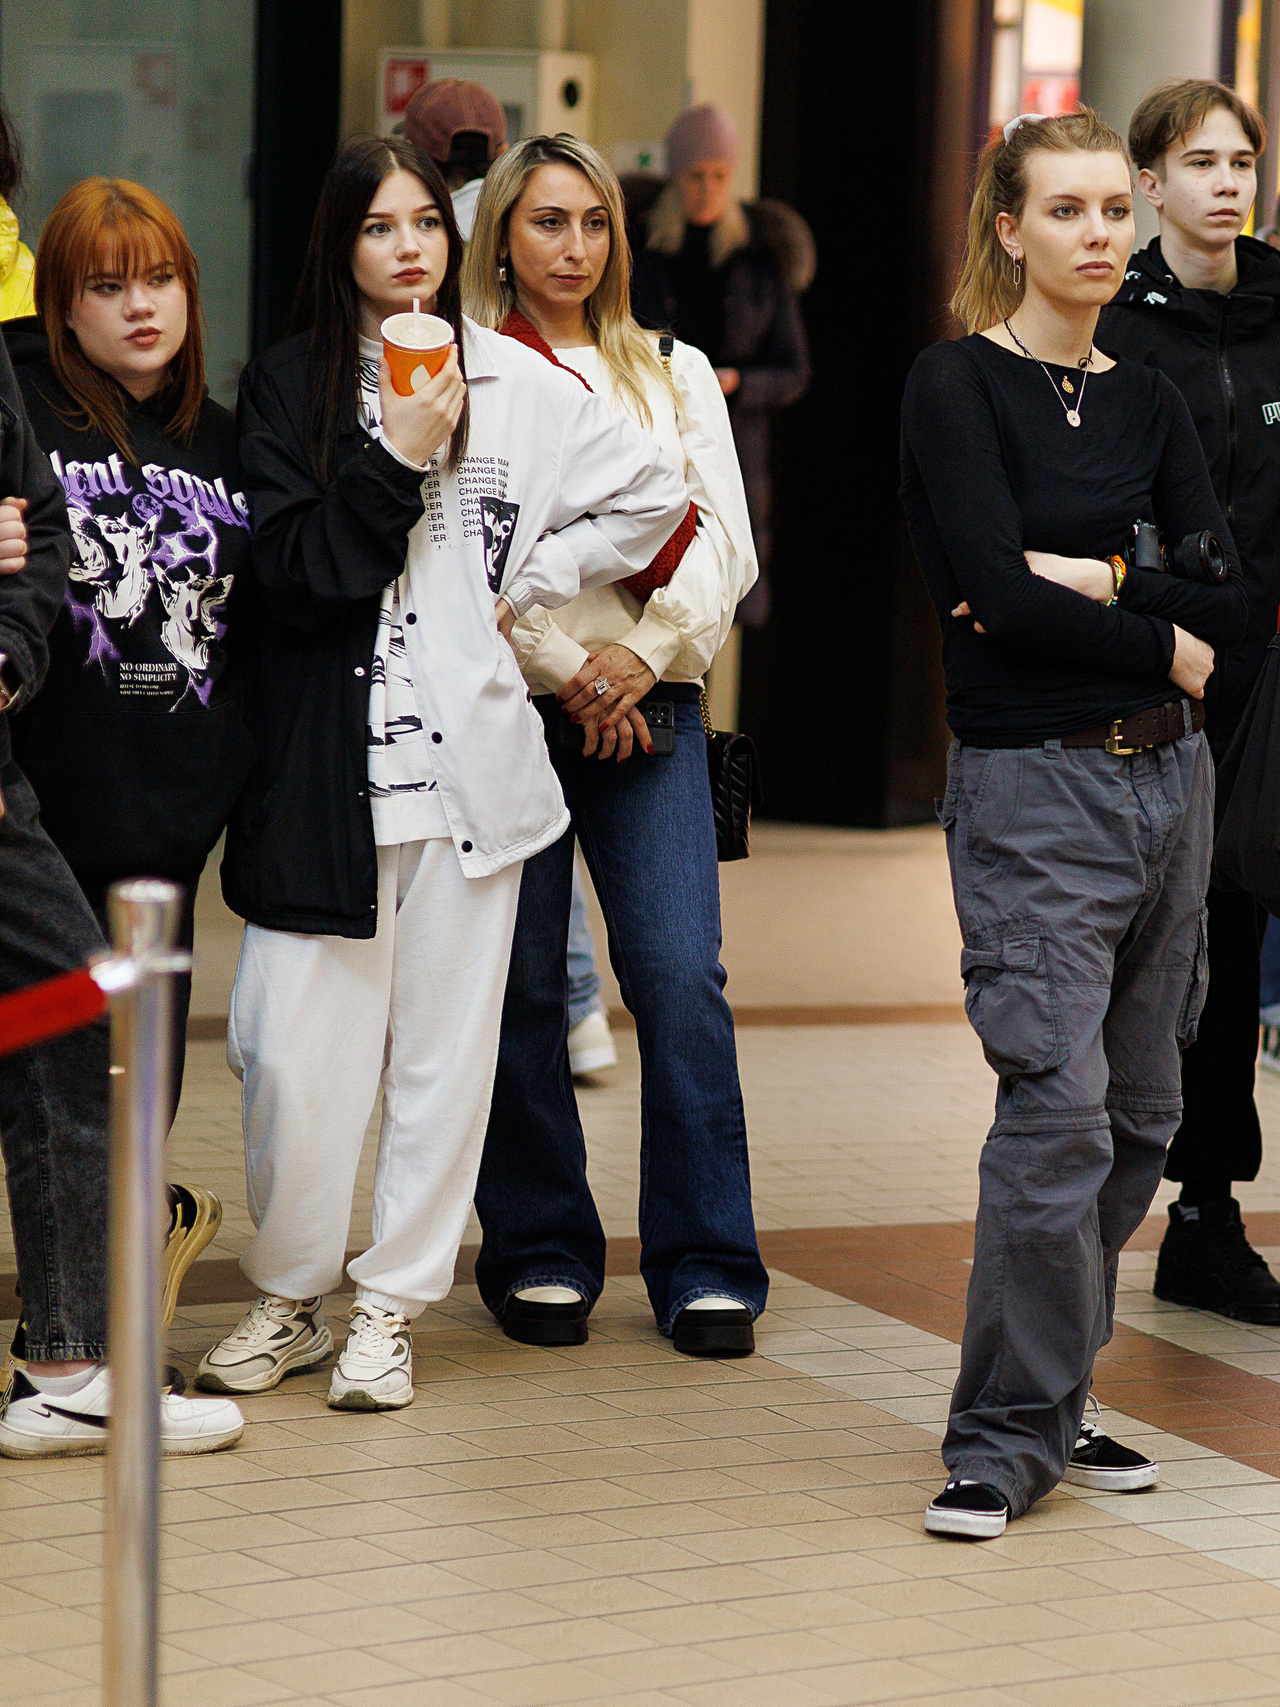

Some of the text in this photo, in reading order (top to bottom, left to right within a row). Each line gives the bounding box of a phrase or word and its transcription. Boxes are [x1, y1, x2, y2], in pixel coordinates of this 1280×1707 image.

[456, 456, 496, 465] CHANGE
[457, 467, 497, 475] CHANGE
[458, 477, 497, 485] CHANGE
[459, 487, 498, 496] CHANGE
[120, 662, 177, 672] NO ORDINARY
[119, 672, 177, 682] NO SIMPLICITY
